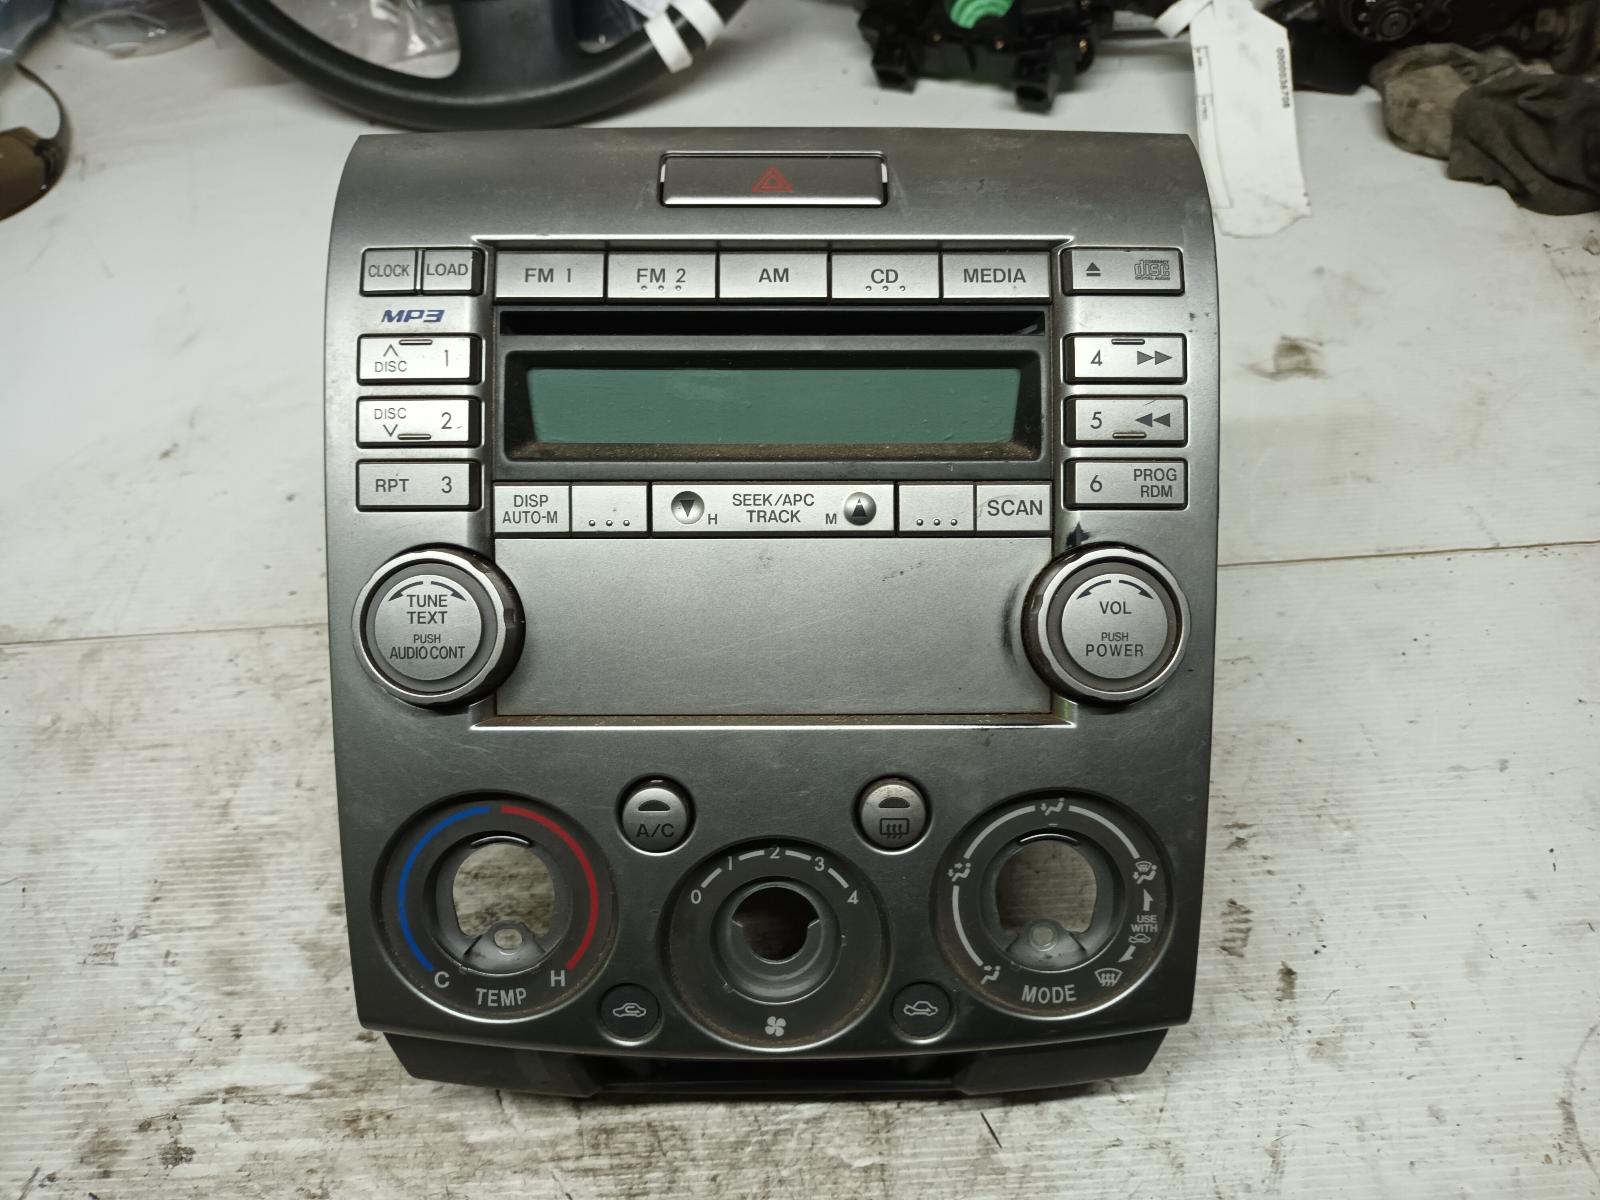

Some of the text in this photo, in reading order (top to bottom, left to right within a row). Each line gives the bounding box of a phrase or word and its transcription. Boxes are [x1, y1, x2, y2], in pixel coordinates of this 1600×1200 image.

[368, 264, 410, 277] CLOCK
[426, 263, 469, 277] LOAD
[525, 268, 572, 283] FM 1
[636, 268, 687, 283] FM 2
[758, 268, 789, 283] AM
[871, 268, 899, 284] CD
[963, 268, 1026, 283] MEDIA
[381, 309, 445, 323] MP3
[443, 349, 449, 367] 1
[1090, 350, 1103, 367] 4
[374, 360, 407, 373] DISC
[374, 408, 407, 420] DISC
[441, 412, 452, 430] 2
[1090, 411, 1102, 429] 5
[1133, 468, 1177, 481] PROG
[375, 479, 409, 493] RPT
[441, 477, 452, 493] 3
[1090, 475, 1103, 493] 6
[1140, 485, 1172, 498] RDM
[513, 494, 549, 508] DISP
[732, 493, 815, 507] SEEK/APC
[987, 499, 1043, 516] SCAN
[502, 511, 558, 524] AUTO-M
[707, 514, 718, 525] H
[746, 510, 801, 523] TRACK
[825, 514, 837, 525] M
[407, 594, 448, 608] TUNE
[1100, 601, 1132, 614] VOL
[407, 611, 448, 624] TEXT
[413, 634, 441, 643] PUSH
[1101, 632, 1129, 641] PUSH
[390, 646, 465, 659] AUDIO CONT
[1085, 644, 1144, 657] POWER
[637, 823, 675, 838] A/C
[690, 847, 859, 905] 0 1 2 3 4
[1136, 914, 1158, 923] USE
[1131, 923, 1158, 933] WITH
[434, 971, 450, 988] C
[550, 970, 566, 987] H
[476, 987, 527, 1007] TEMP
[1022, 984, 1077, 1004] MODE
